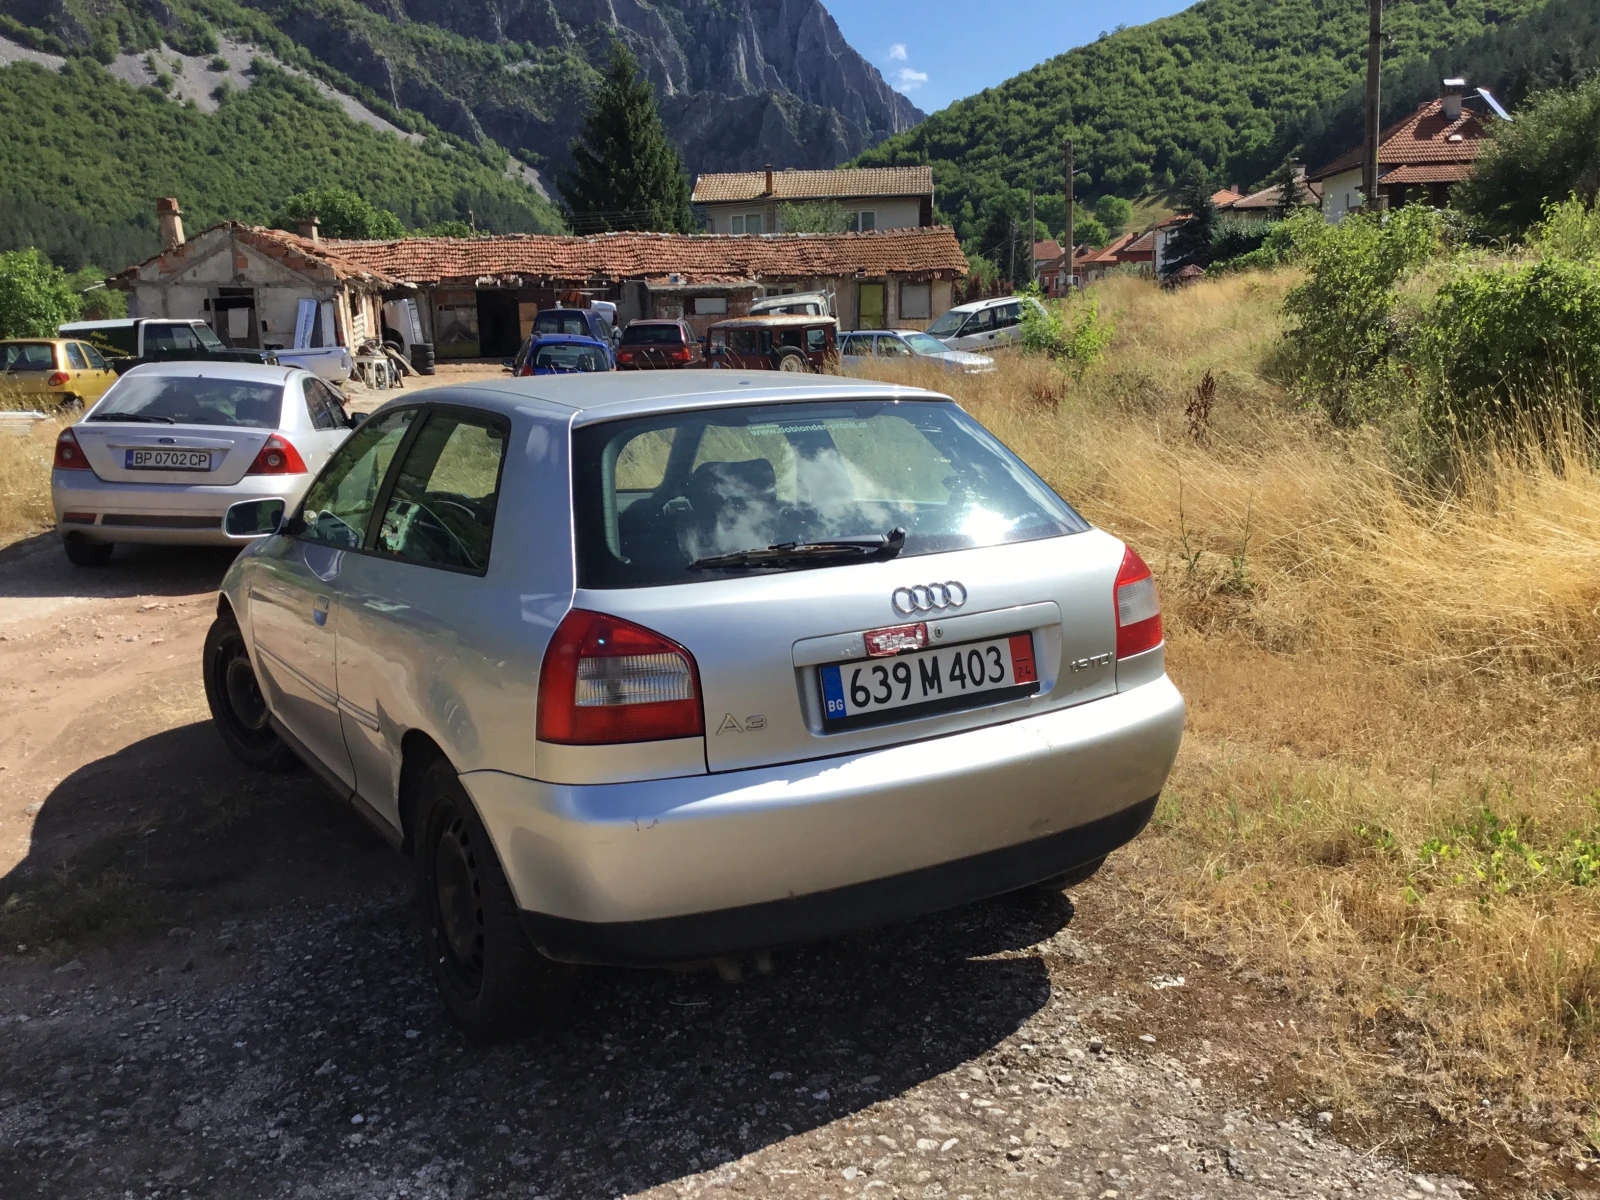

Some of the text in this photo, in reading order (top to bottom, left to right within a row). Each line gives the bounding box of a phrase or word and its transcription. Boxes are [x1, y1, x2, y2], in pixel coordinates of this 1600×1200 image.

[135, 452, 207, 467] BP 0702 CP
[850, 645, 1005, 708] 639 M 403
[828, 699, 844, 713] BG
[716, 712, 767, 736] A3
